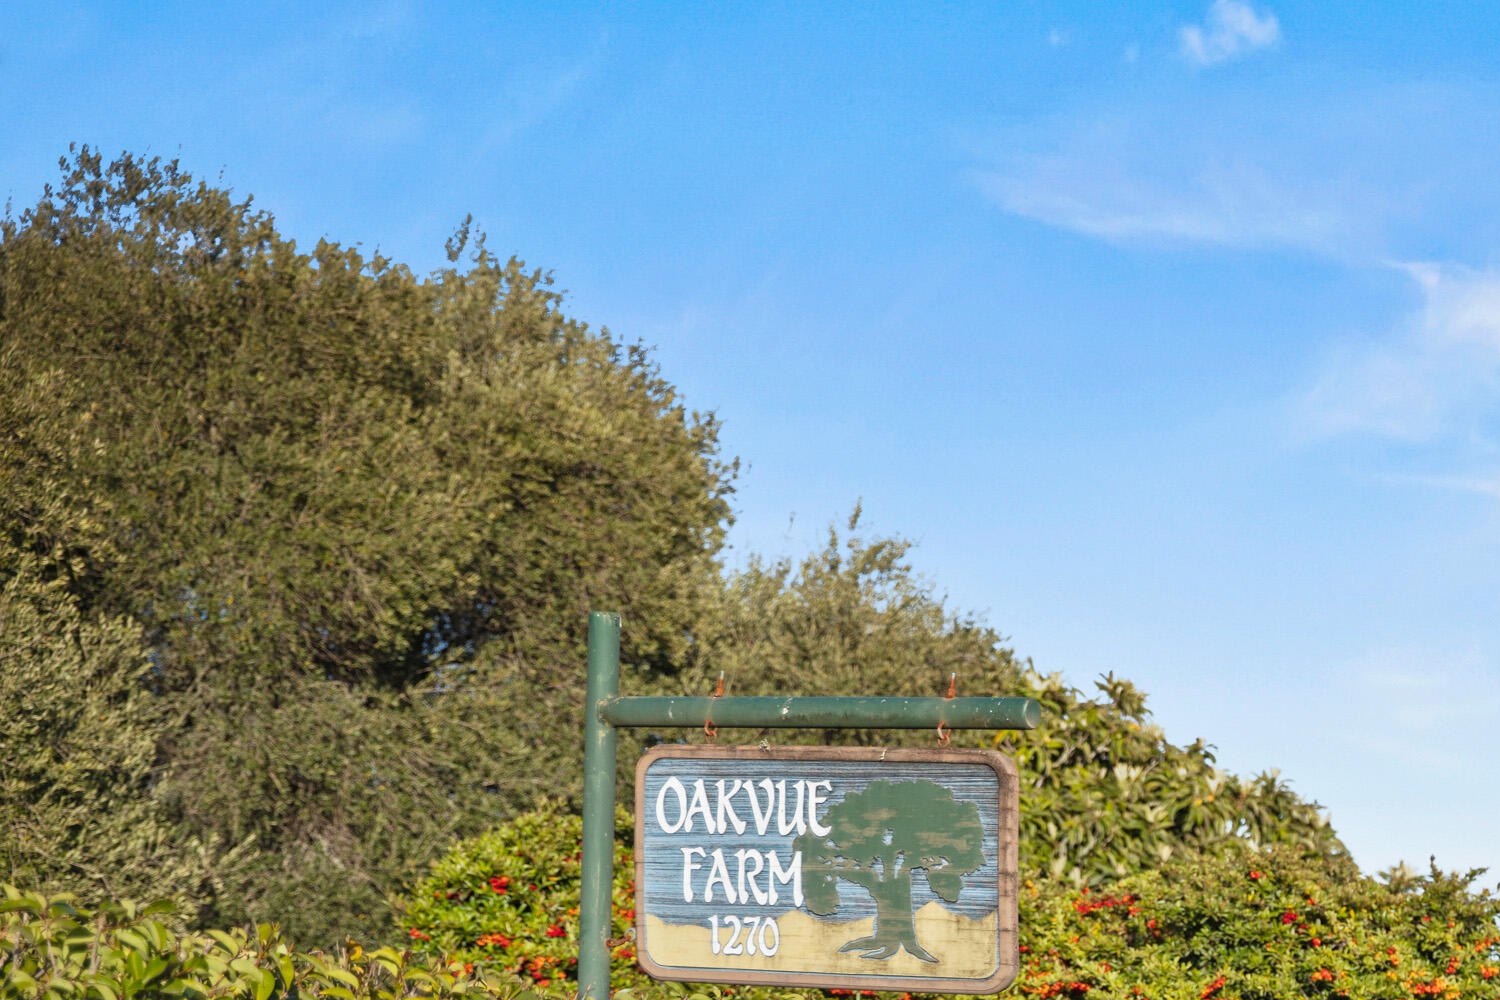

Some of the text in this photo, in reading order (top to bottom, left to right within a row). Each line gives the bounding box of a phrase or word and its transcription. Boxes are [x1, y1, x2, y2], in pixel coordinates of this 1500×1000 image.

[655, 776, 833, 837] OAKVUE
[681, 847, 804, 907] FARM
[708, 914, 780, 957] 1270
